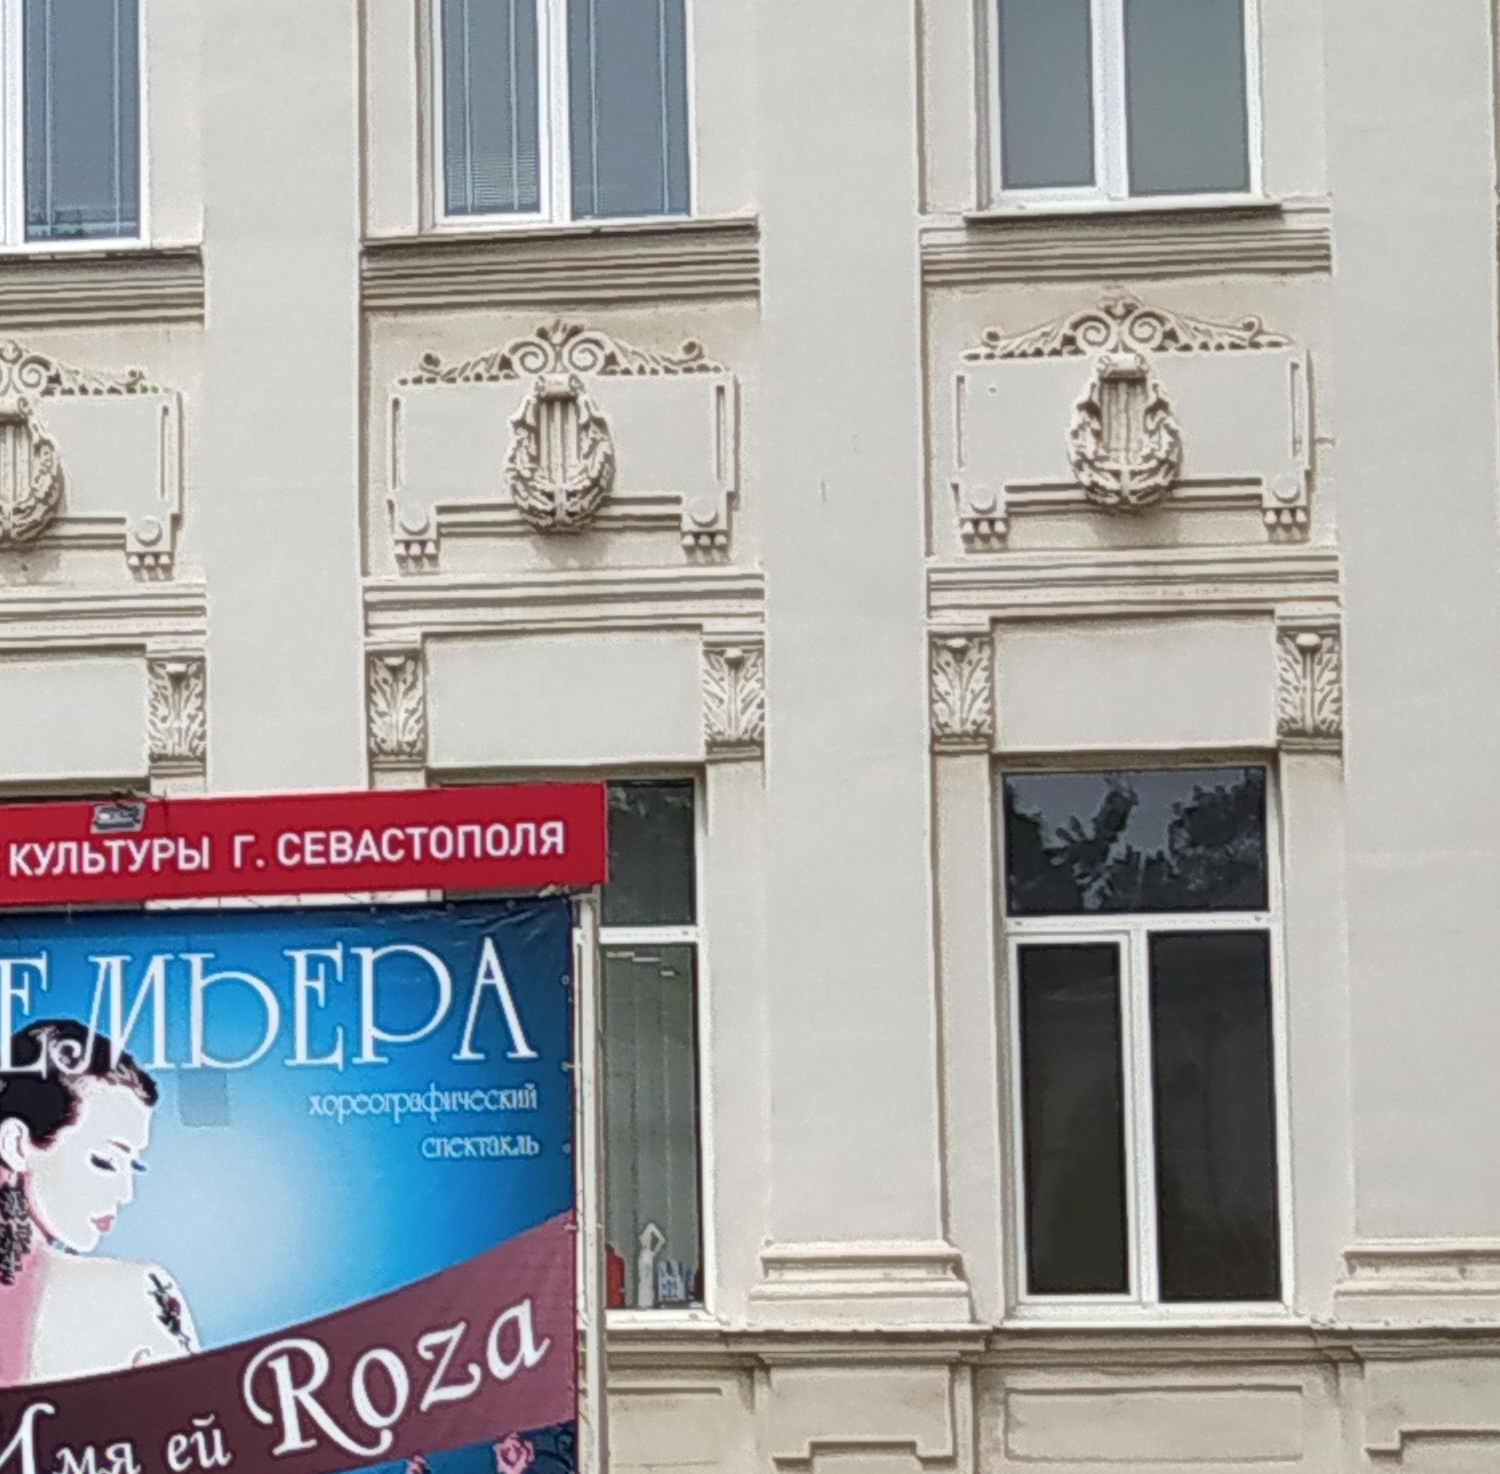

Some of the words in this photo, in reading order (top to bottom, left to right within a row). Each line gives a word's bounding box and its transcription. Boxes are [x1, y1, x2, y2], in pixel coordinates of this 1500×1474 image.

[8, 834, 211, 878] КУЛЬТУРЫ
[233, 834, 266, 870] Г.
[276, 820, 567, 868] СЕВАСТОПОЛЯ
[308, 1082, 538, 1126] хореографический
[421, 1134, 540, 1160] спектакль
[166, 1414, 232, 1471] ей
